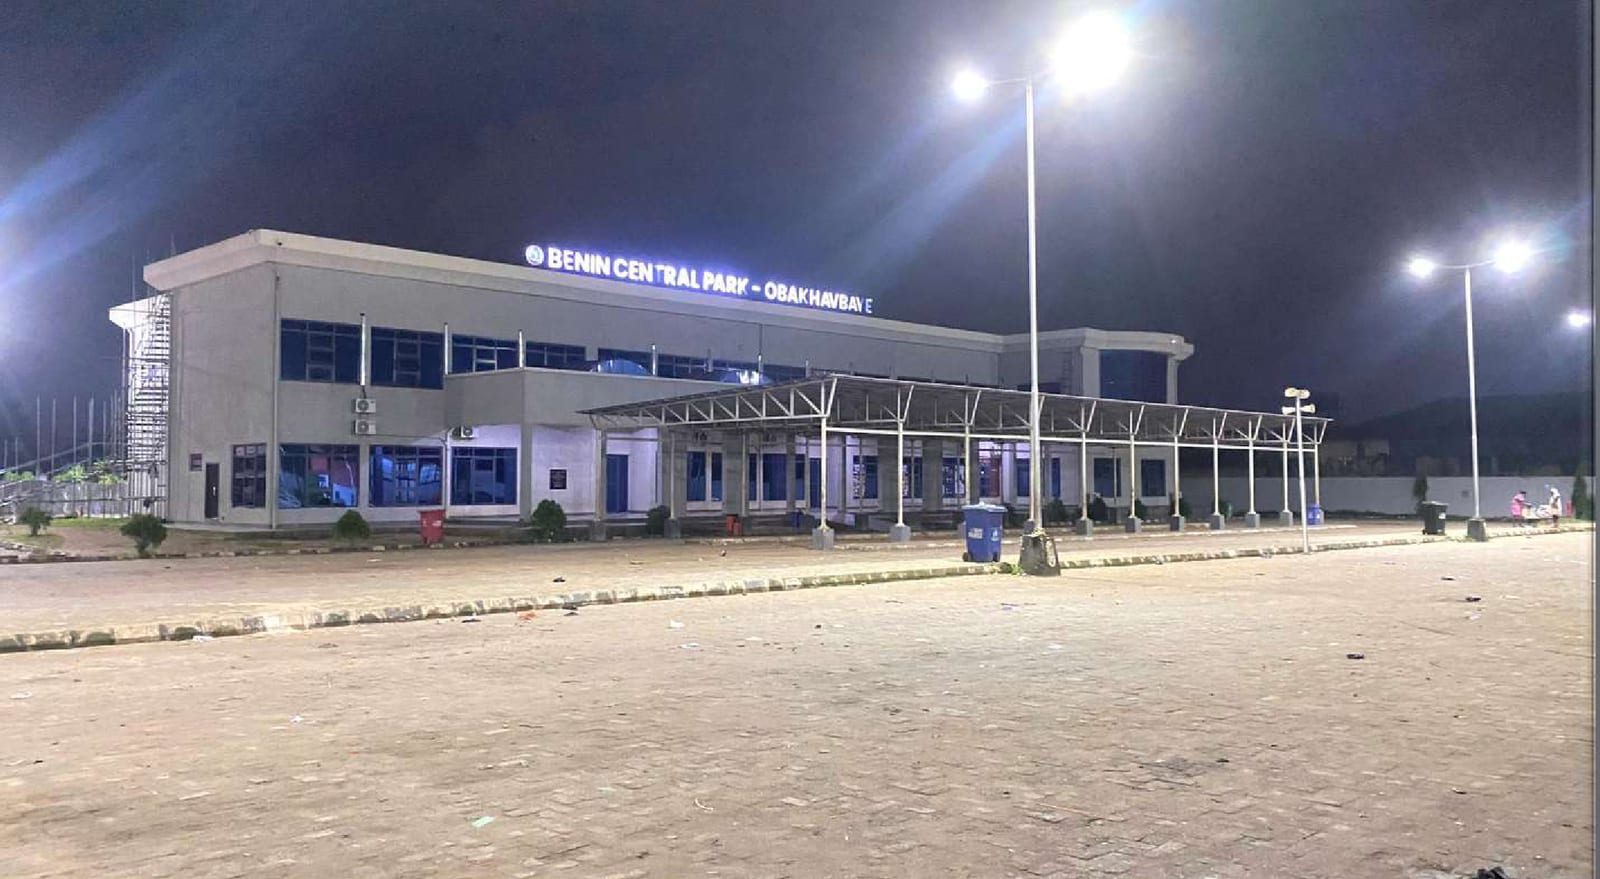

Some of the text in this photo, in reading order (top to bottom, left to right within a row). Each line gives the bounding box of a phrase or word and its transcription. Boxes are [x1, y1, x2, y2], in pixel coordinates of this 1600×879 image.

[548, 247, 611, 276] BENIN
[613, 258, 700, 289] CENTRAL
[702, 271, 749, 296] PARK
[764, 281, 874, 314] OBAKHAVBAYE
